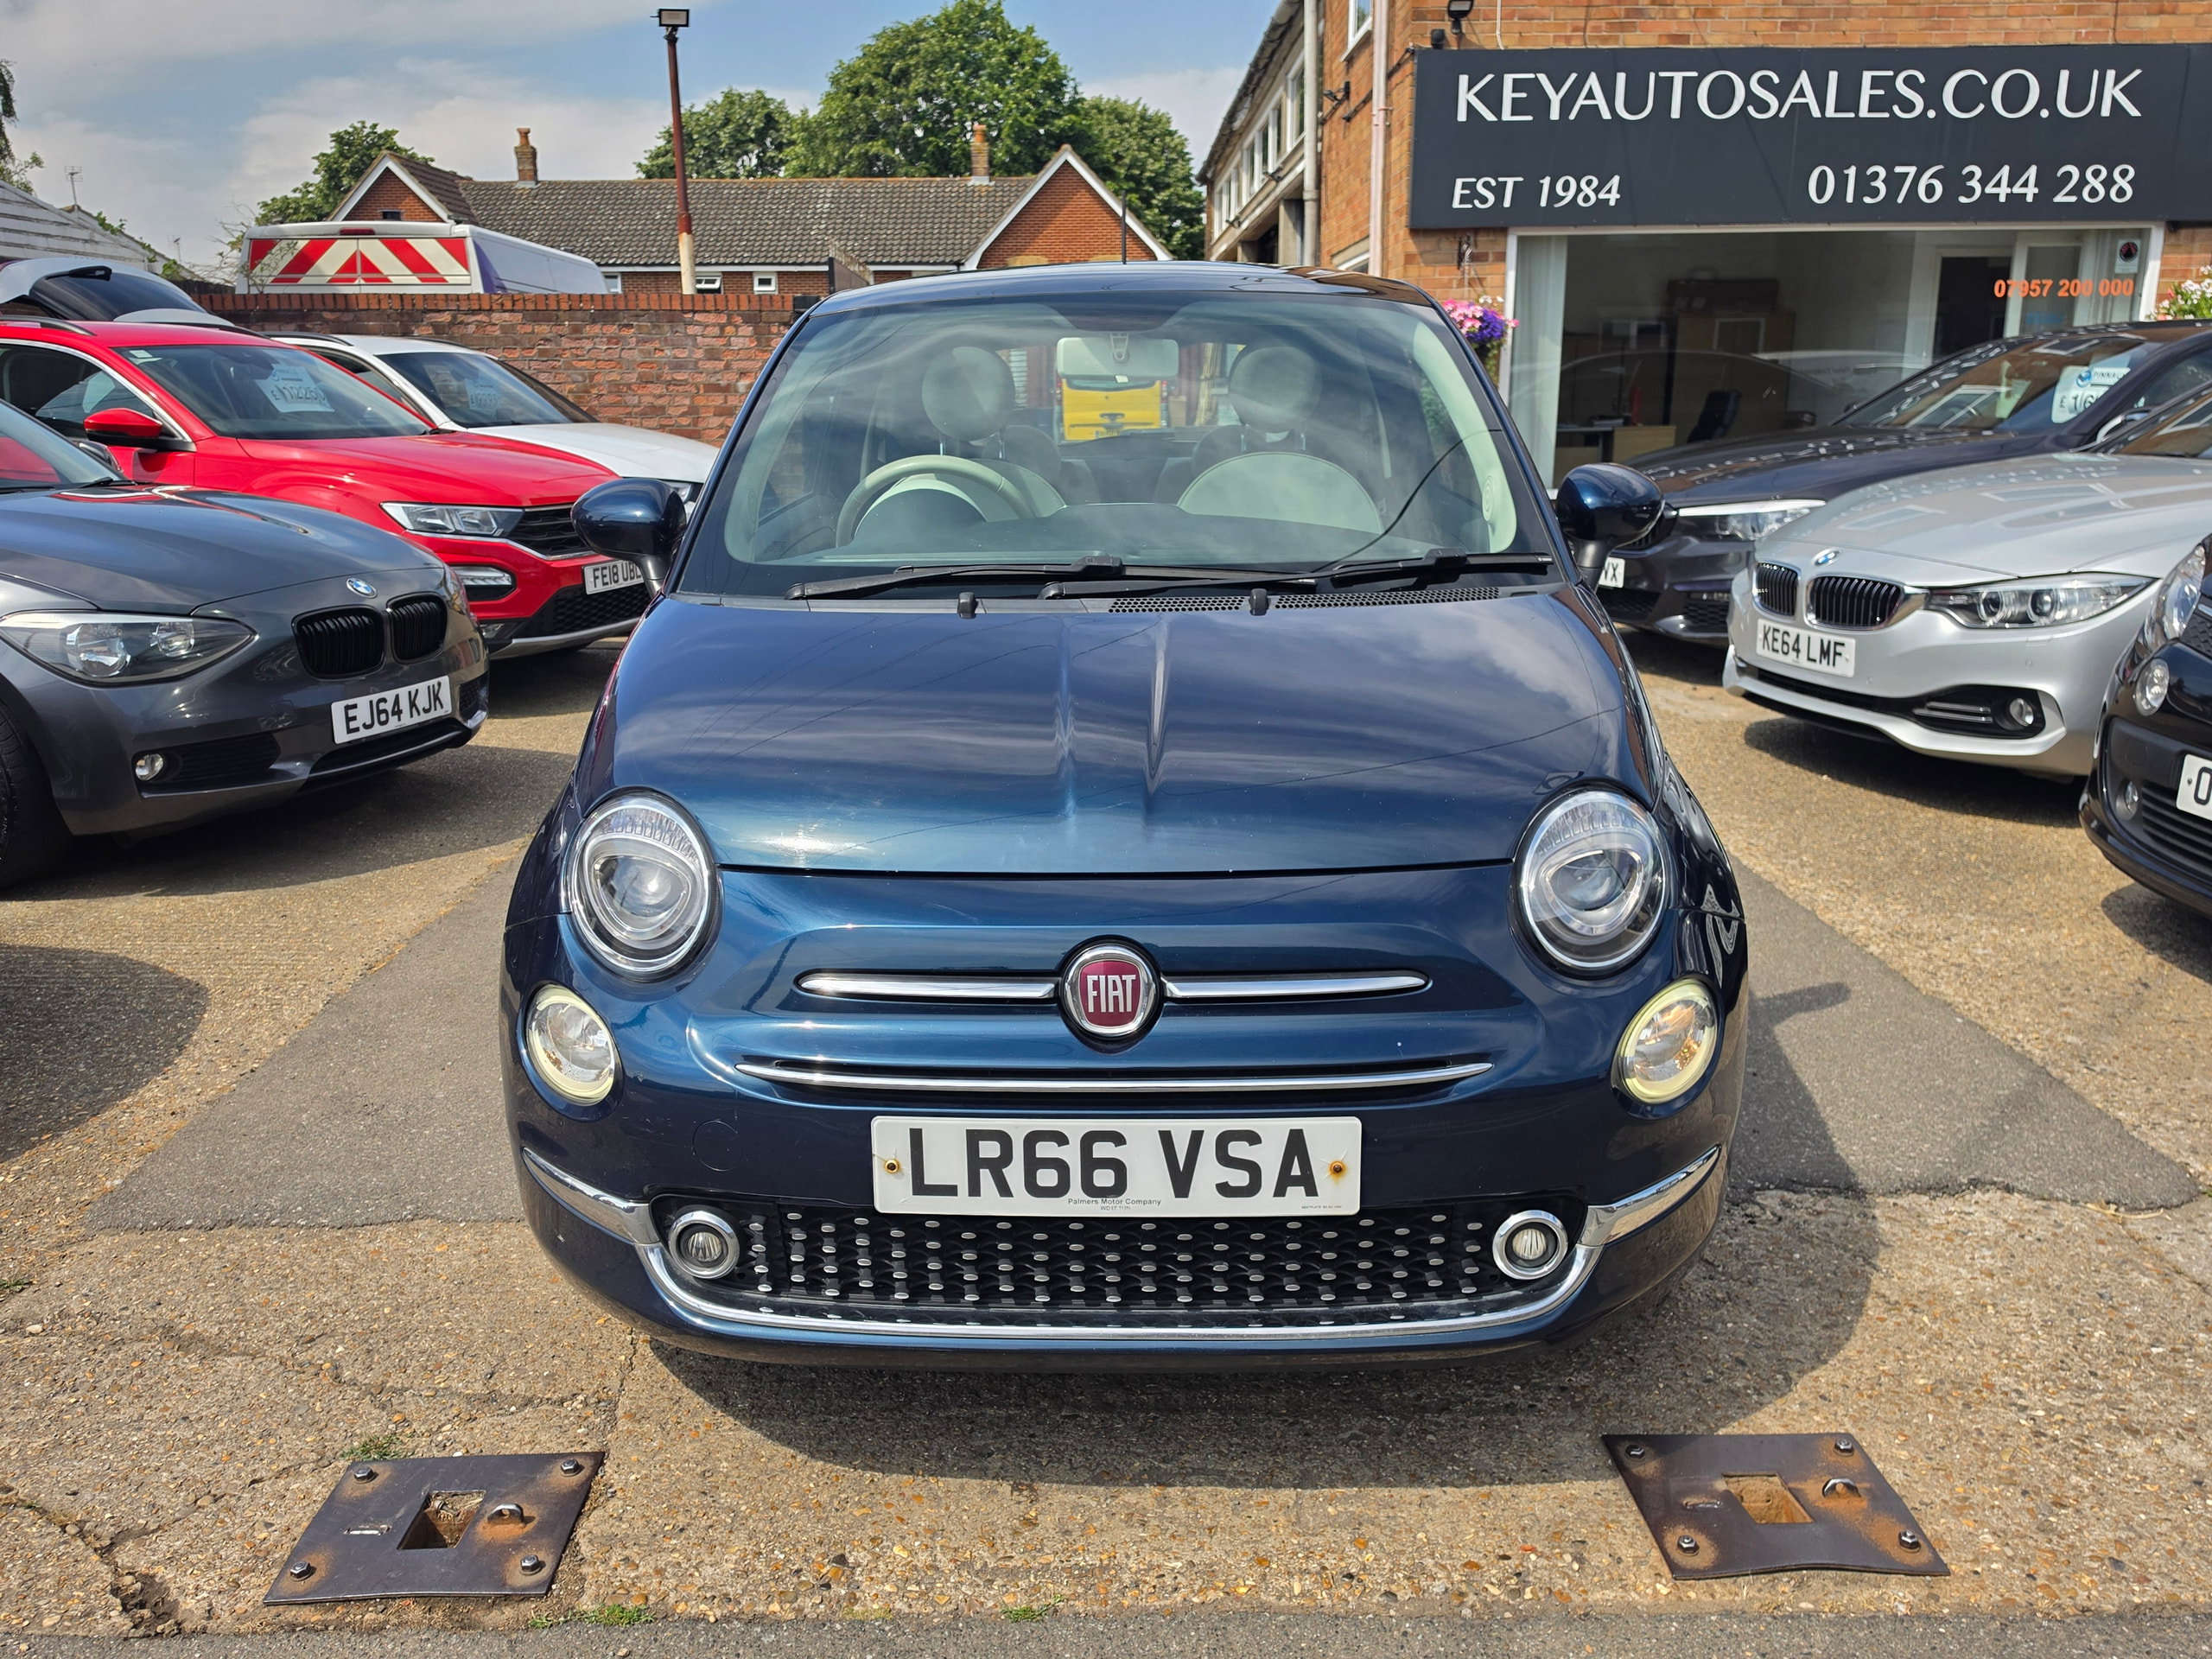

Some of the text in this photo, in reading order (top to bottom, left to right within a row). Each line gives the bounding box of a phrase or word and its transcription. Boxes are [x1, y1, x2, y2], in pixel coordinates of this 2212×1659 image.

[1457, 68, 2143, 122] KEYAUTOSALES.CO.UK
[1452, 175, 1621, 209] EST 1984
[1808, 164, 2136, 204] 01376 344 288
[1993, 278, 2135, 297] 07957 200 000
[593, 564, 620, 588] FE18
[1763, 625, 1846, 668] KE64 LMF
[344, 681, 444, 734] EJ64 KJK
[1086, 974, 1136, 1013] FIAT
[908, 1127, 1319, 1198] LR66 VSA
